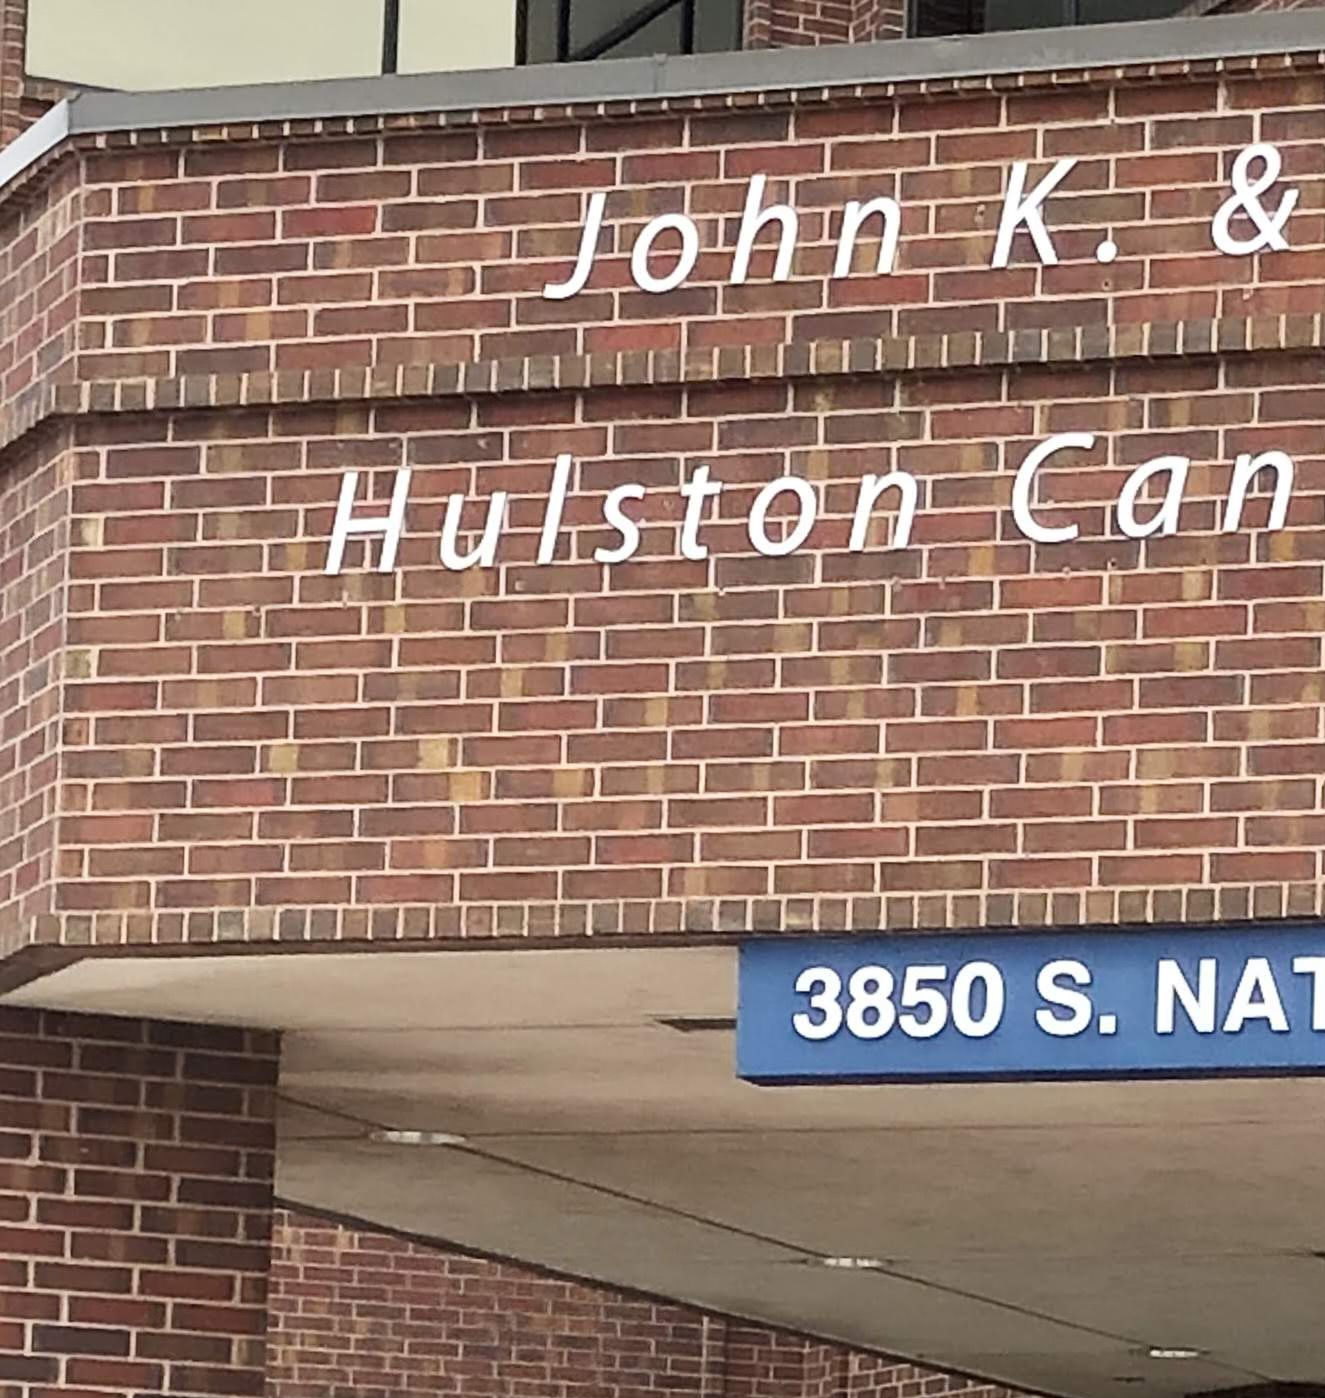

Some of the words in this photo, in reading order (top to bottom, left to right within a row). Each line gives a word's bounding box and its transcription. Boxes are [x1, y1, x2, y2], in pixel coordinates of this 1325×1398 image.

[545, 175, 902, 300] John
[994, 159, 1118, 268] K.
[1213, 143, 1299, 256] &
[327, 455, 918, 576] Hulston
[793, 961, 1005, 1039] 3850
[1036, 960, 1116, 1035] S.
